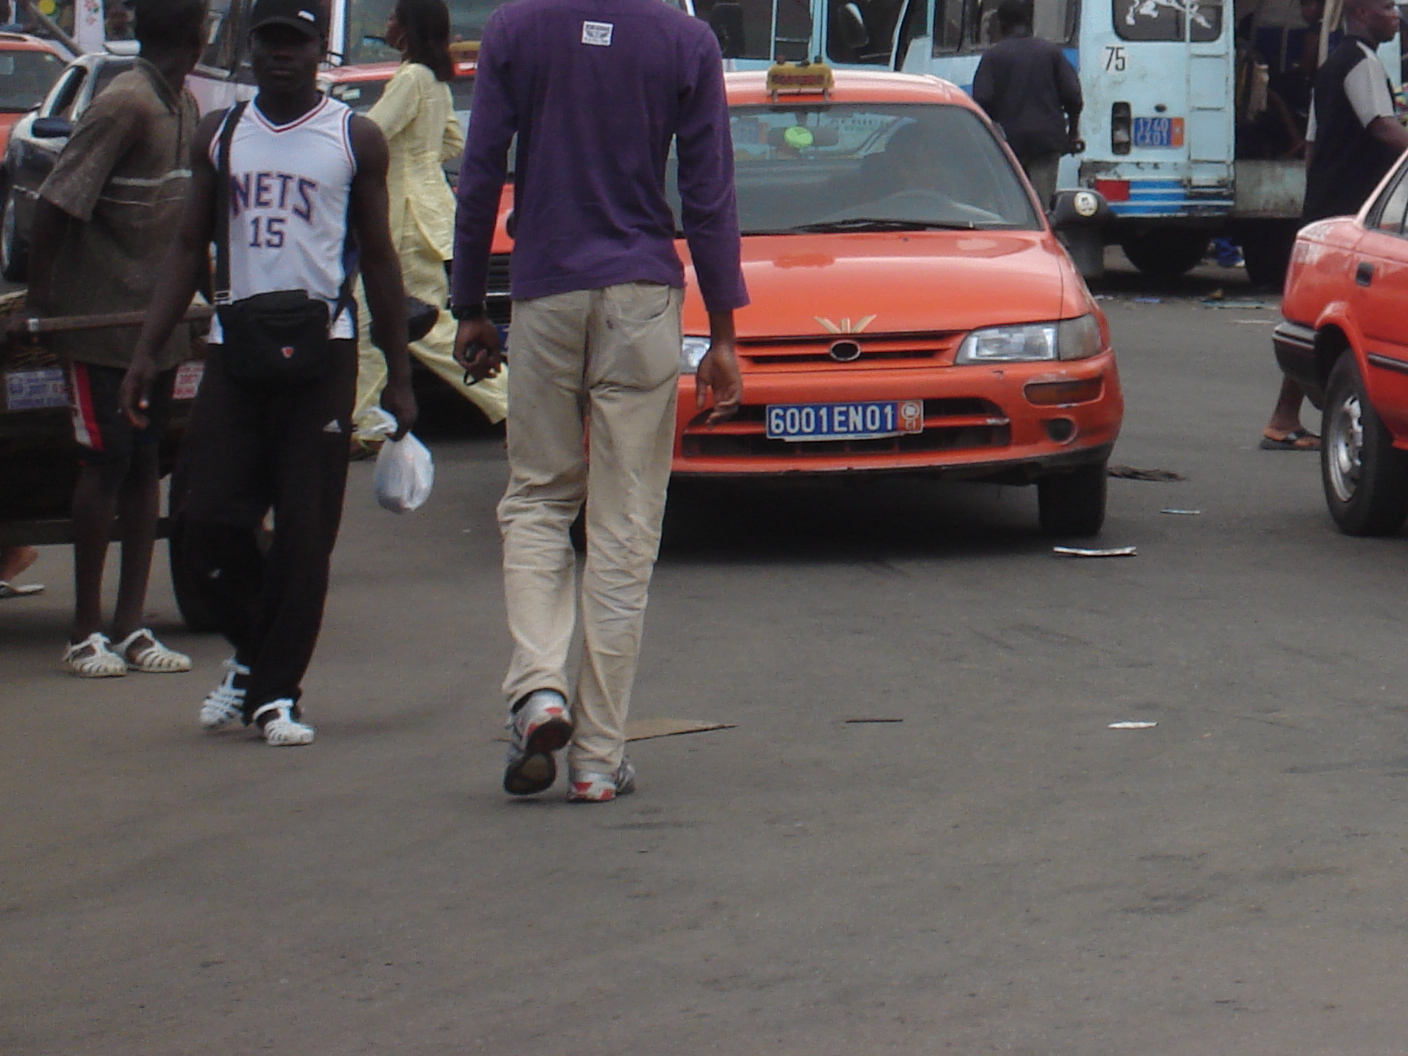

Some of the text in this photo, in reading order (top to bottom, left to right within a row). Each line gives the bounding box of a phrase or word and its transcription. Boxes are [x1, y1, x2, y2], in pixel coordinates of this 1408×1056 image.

[1105, 46, 1126, 71] 75
[229, 171, 318, 225] NETS
[248, 215, 286, 249] 15
[770, 404, 895, 434] 6001EN01
